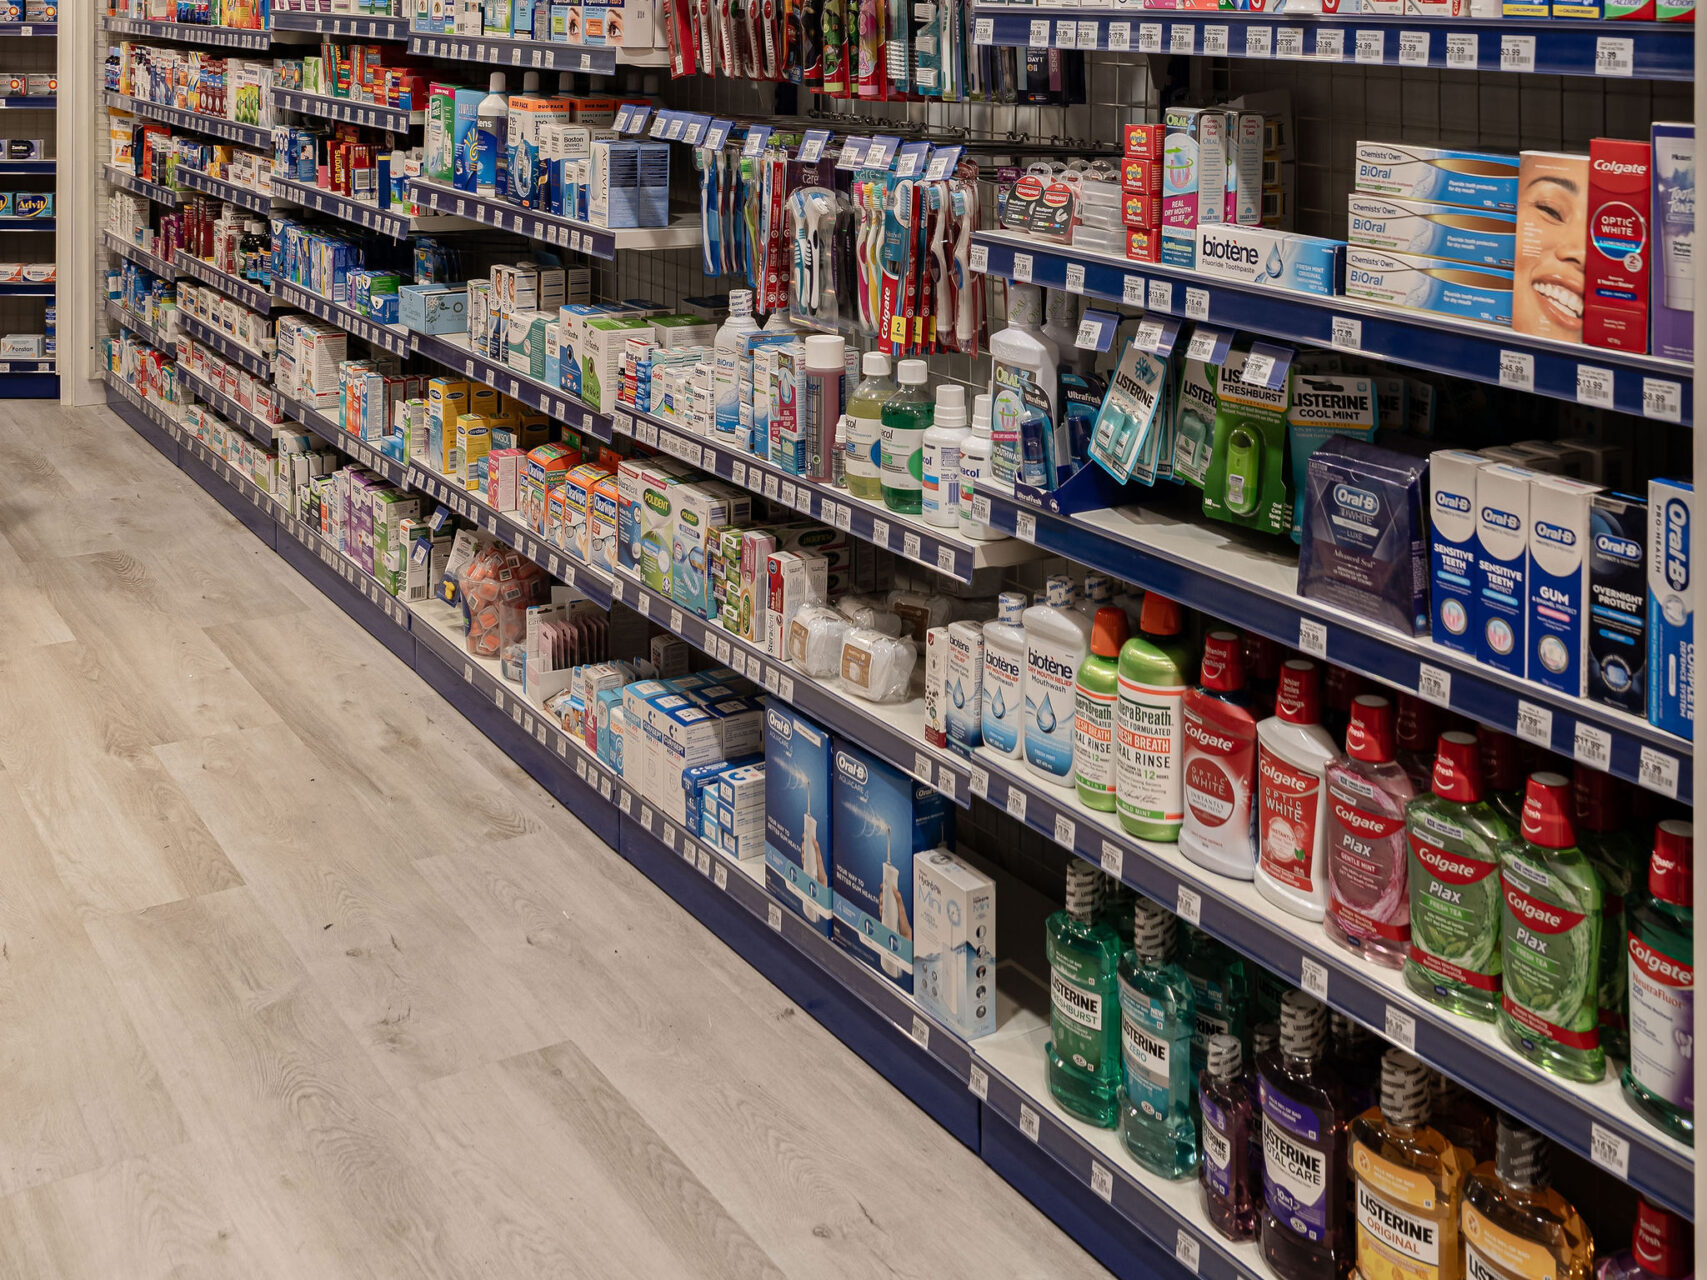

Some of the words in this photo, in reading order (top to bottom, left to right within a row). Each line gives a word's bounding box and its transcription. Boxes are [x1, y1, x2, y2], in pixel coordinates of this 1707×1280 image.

[1386, 153, 1401, 161] Own
[1359, 165, 1391, 180] BiOral
[1594, 160, 1646, 176] Colgate
[18, 200, 44, 208] Advil
[1172, 200, 1184, 208] REAL
[1175, 206, 1191, 215] MOUTH
[1353, 219, 1385, 233] BiOral
[1601, 216, 1632, 225] OPTIC
[1601, 225, 1633, 237] WHITE
[1203, 235, 1259, 264] biotène
[1202, 258, 1223, 269] Fluoride
[1225, 263, 1255, 275] Toothpaste
[1350, 271, 1383, 286] BiOral
[881, 286, 890, 339] Colgate
[717, 357, 735, 368] BiOral
[1115, 371, 1155, 410] LISTERINE
[1224, 386, 1283, 402] FRESHBURST
[1299, 409, 1328, 419] COOL
[1330, 409, 1360, 420] MINT
[644, 493, 669, 511] POLIDENT
[1337, 488, 1377, 512] Oral-B
[1437, 494, 1470, 510] Oral-B
[1483, 510, 1519, 528] Oral-B
[1536, 524, 1575, 542] Oral-B
[1434, 543, 1474, 561] SENSITIVE
[1598, 536, 1641, 557] Oral-B
[1442, 557, 1466, 569] TEETH
[1479, 561, 1522, 581] SENSITIVE
[1487, 576, 1514, 589] TEETH
[1540, 586, 1569, 604] GUM
[1592, 584, 1643, 605] OVERNIGHT
[1599, 596, 1637, 612] PROTECT
[950, 634, 969, 653] biotène
[986, 649, 1019, 675] biotène
[1028, 647, 1073, 679] biotène
[988, 671, 1013, 687] Mouthwash
[1032, 675, 1066, 694] Mouthwash
[769, 710, 791, 737] Oral-B
[1134, 735, 1168, 752] BREATH
[1185, 722, 1232, 752] Colgate
[839, 755, 867, 781] Oral-B
[1135, 755, 1170, 768] RINSE
[1260, 760, 1307, 790] Colgate
[1265, 787, 1301, 808] OPTIC
[1266, 798, 1300, 821] WHITE
[1336, 805, 1384, 832] Colgate
[1343, 834, 1372, 857] Plax
[1419, 848, 1475, 877] Colgate
[1430, 882, 1460, 904] Plax
[1507, 891, 1561, 926] Colgate
[1516, 928, 1547, 953] Plax
[1128, 1042, 1147, 1061] ZERO
[1263, 1123, 1320, 1174] LISTERINE
[1293, 1163, 1321, 1186] CARE
[1360, 1190, 1433, 1245] LISTERINE
[1367, 1216, 1419, 1255] ORIGINAL
